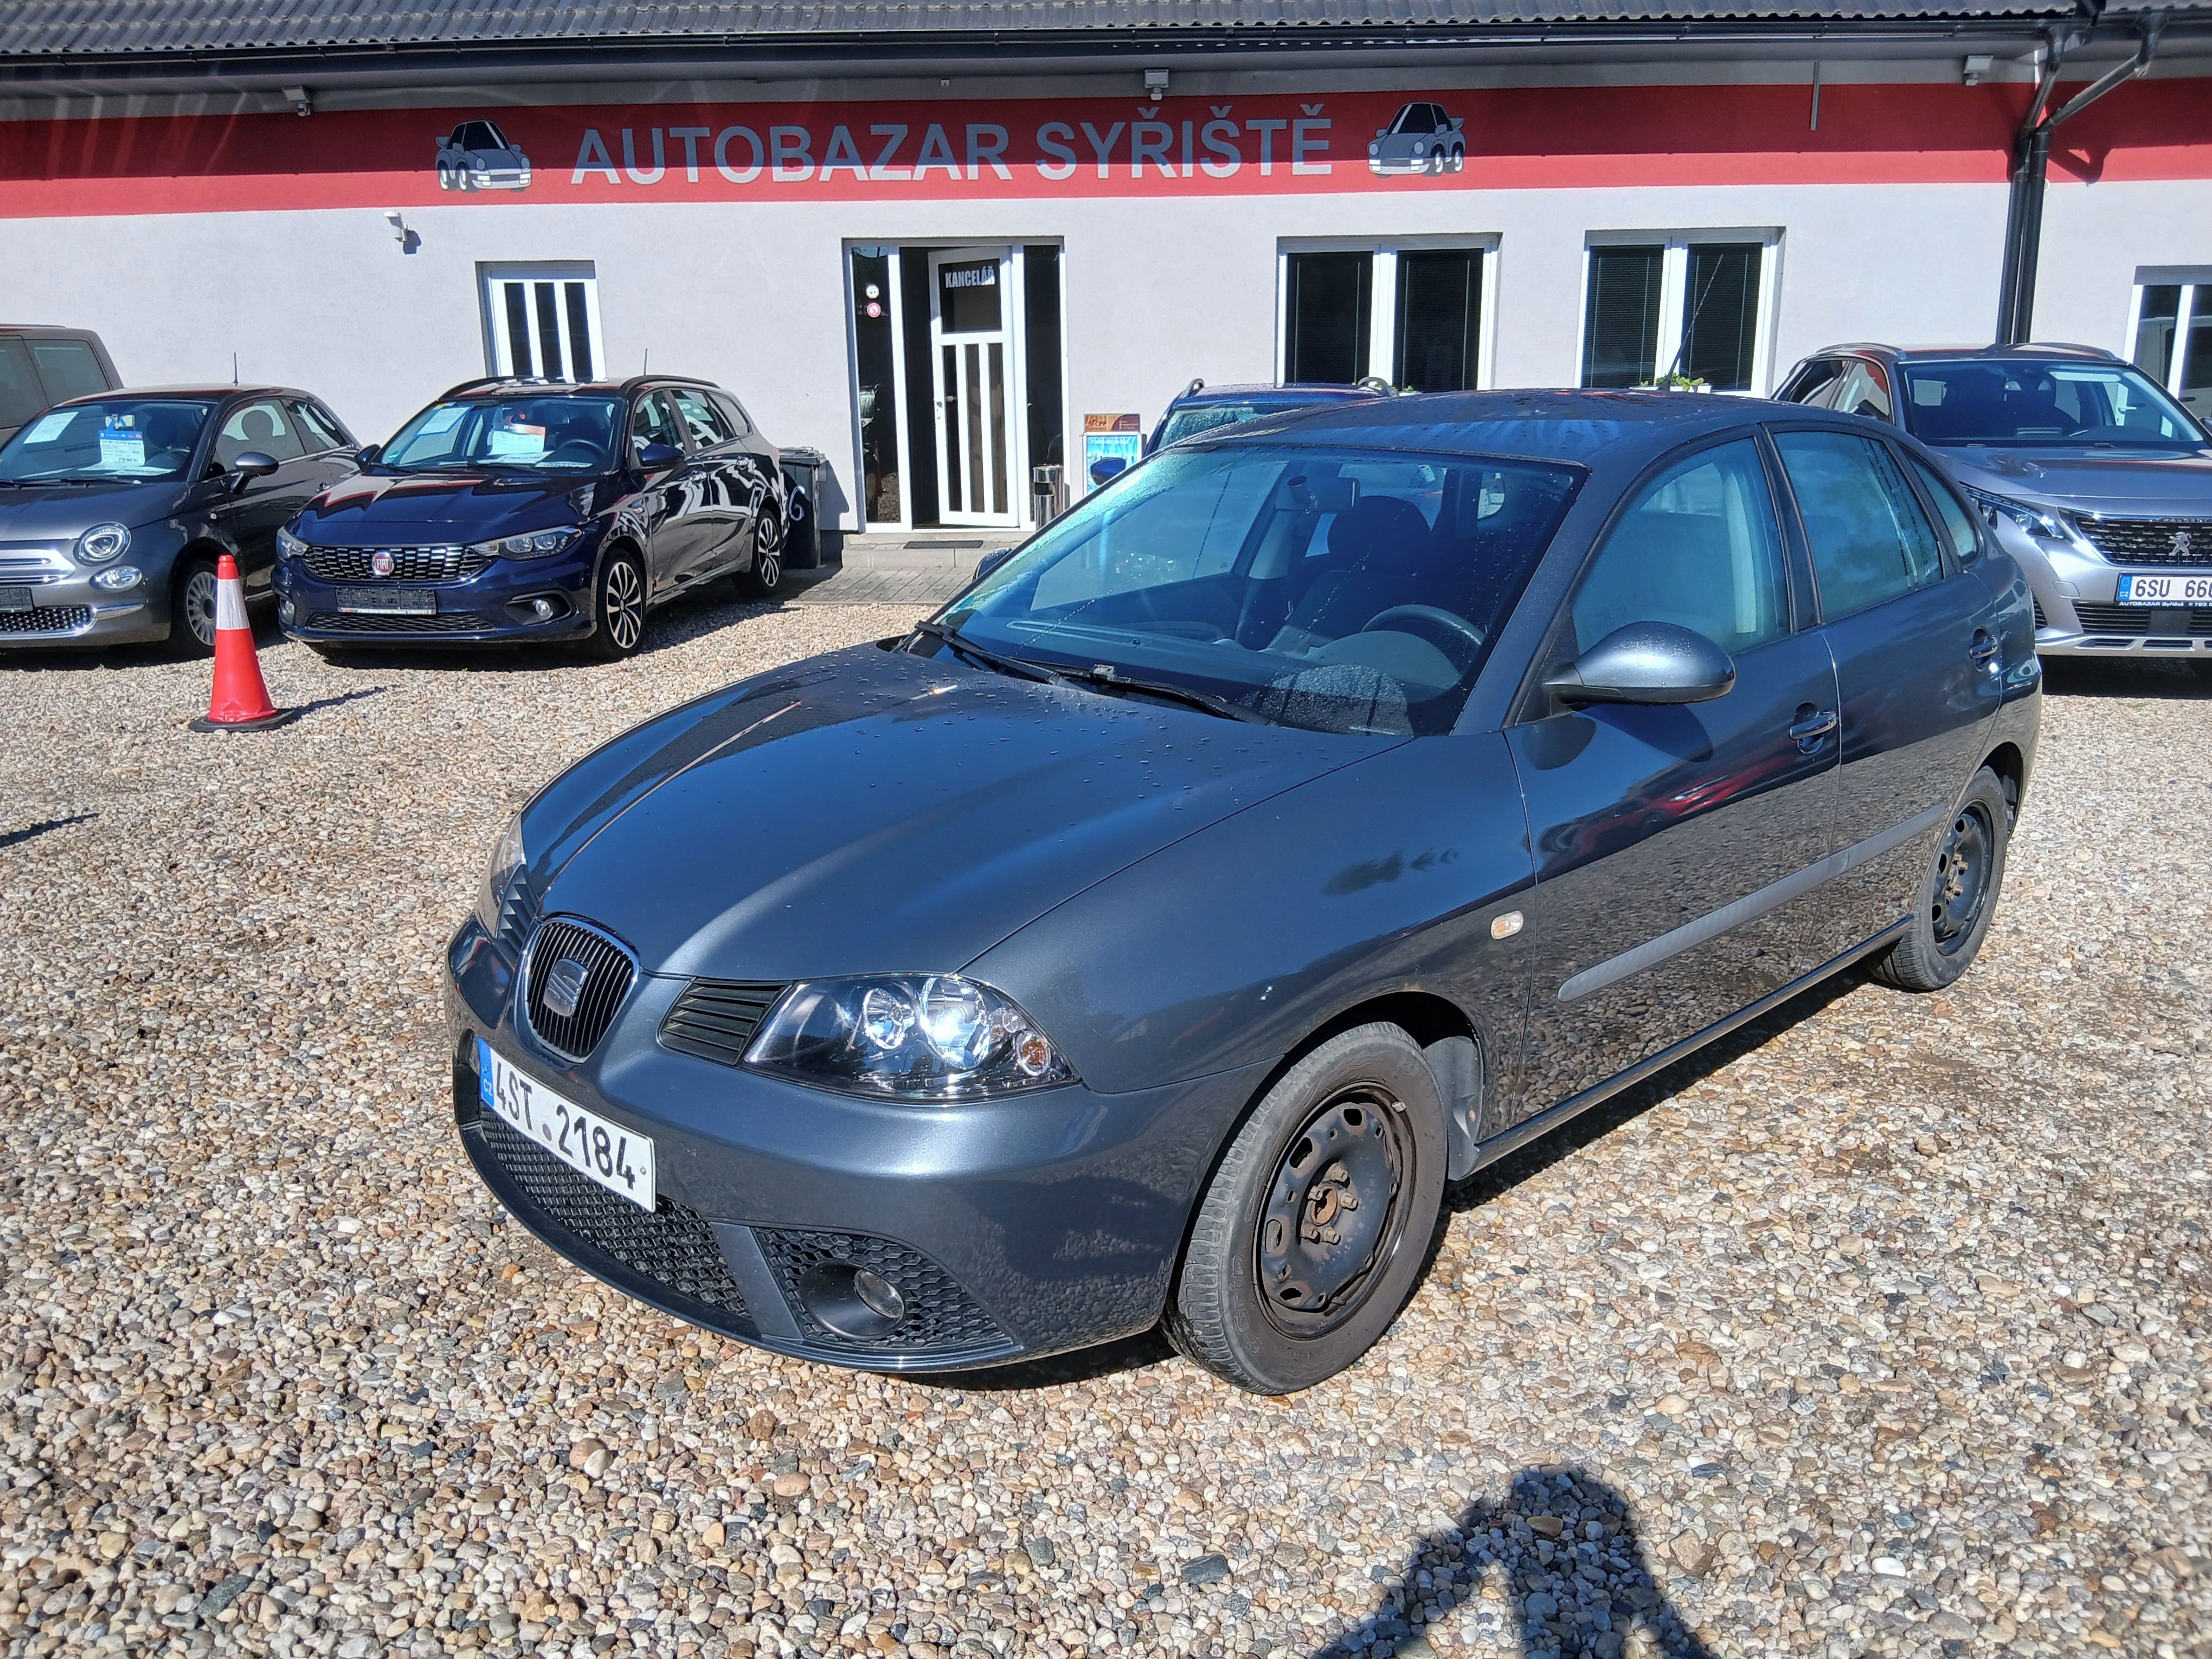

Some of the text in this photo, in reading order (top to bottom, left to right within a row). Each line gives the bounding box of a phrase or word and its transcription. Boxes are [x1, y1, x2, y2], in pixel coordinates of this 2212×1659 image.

[571, 104, 1332, 185] AUTOBAZAR SYŘIŠTĚ
[945, 265, 995, 288] KANCELÁŘ
[376, 558, 389, 570] FIAT
[2135, 579, 2171, 597] 6SU
[483, 1060, 636, 1191] CZ 4ST 2184
